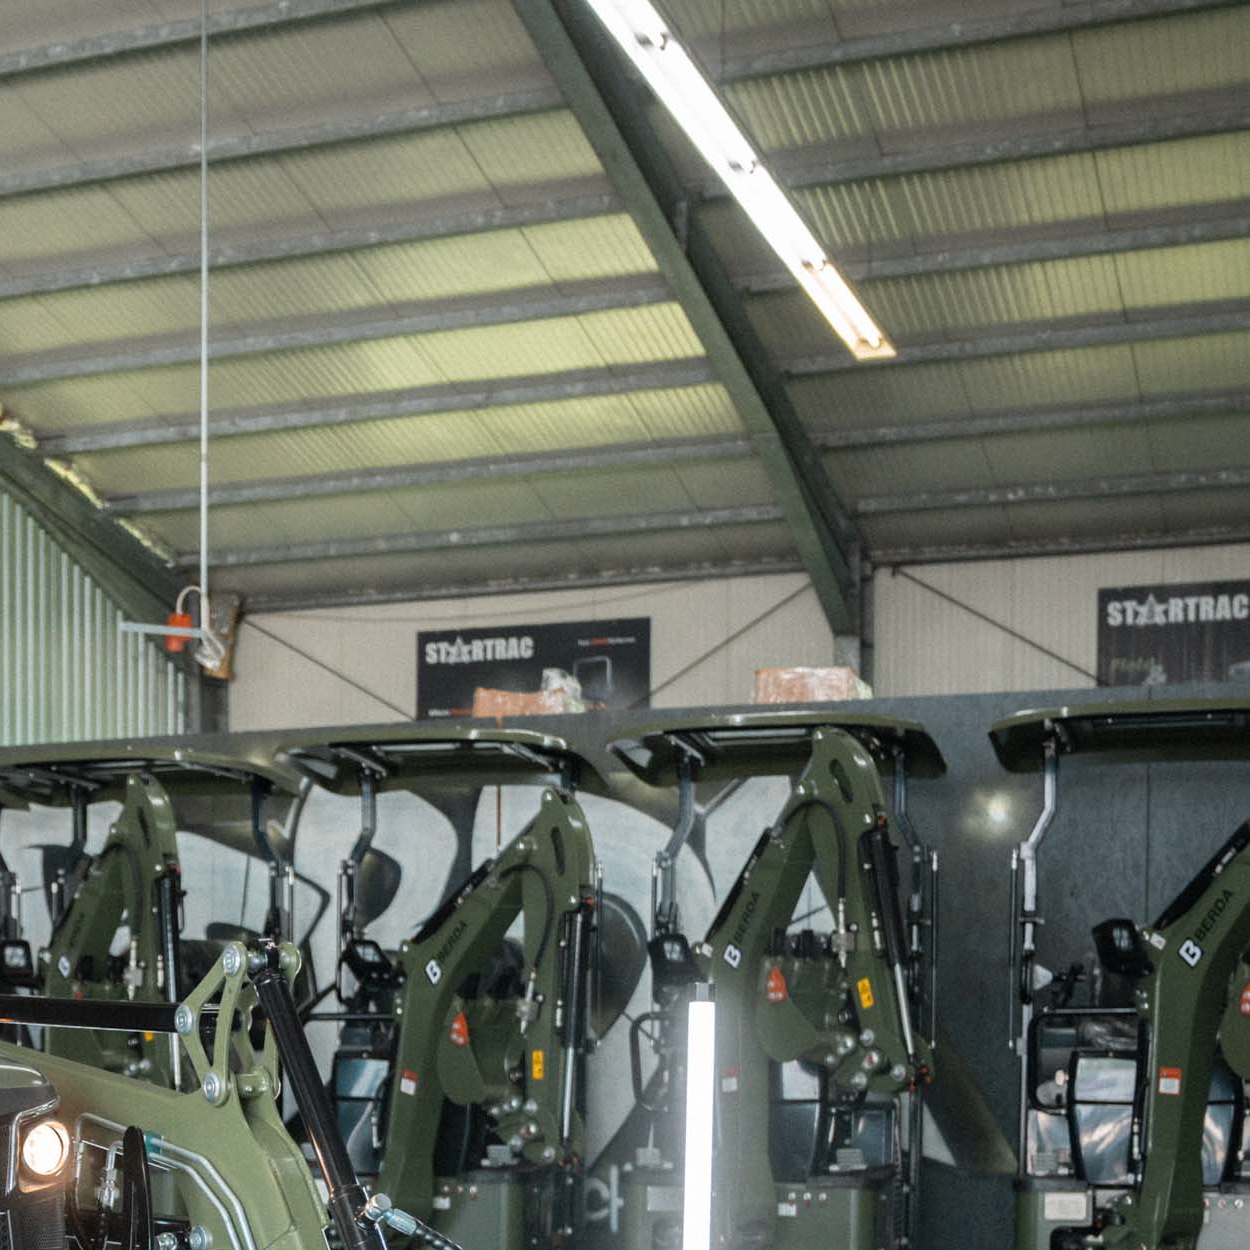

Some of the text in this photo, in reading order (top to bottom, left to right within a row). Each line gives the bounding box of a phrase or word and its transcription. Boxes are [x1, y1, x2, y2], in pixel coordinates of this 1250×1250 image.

[1107, 593, 1249, 627] STARTRAC
[424, 635, 534, 665] STARTRAC
[1194, 889, 1234, 942] BERDA
